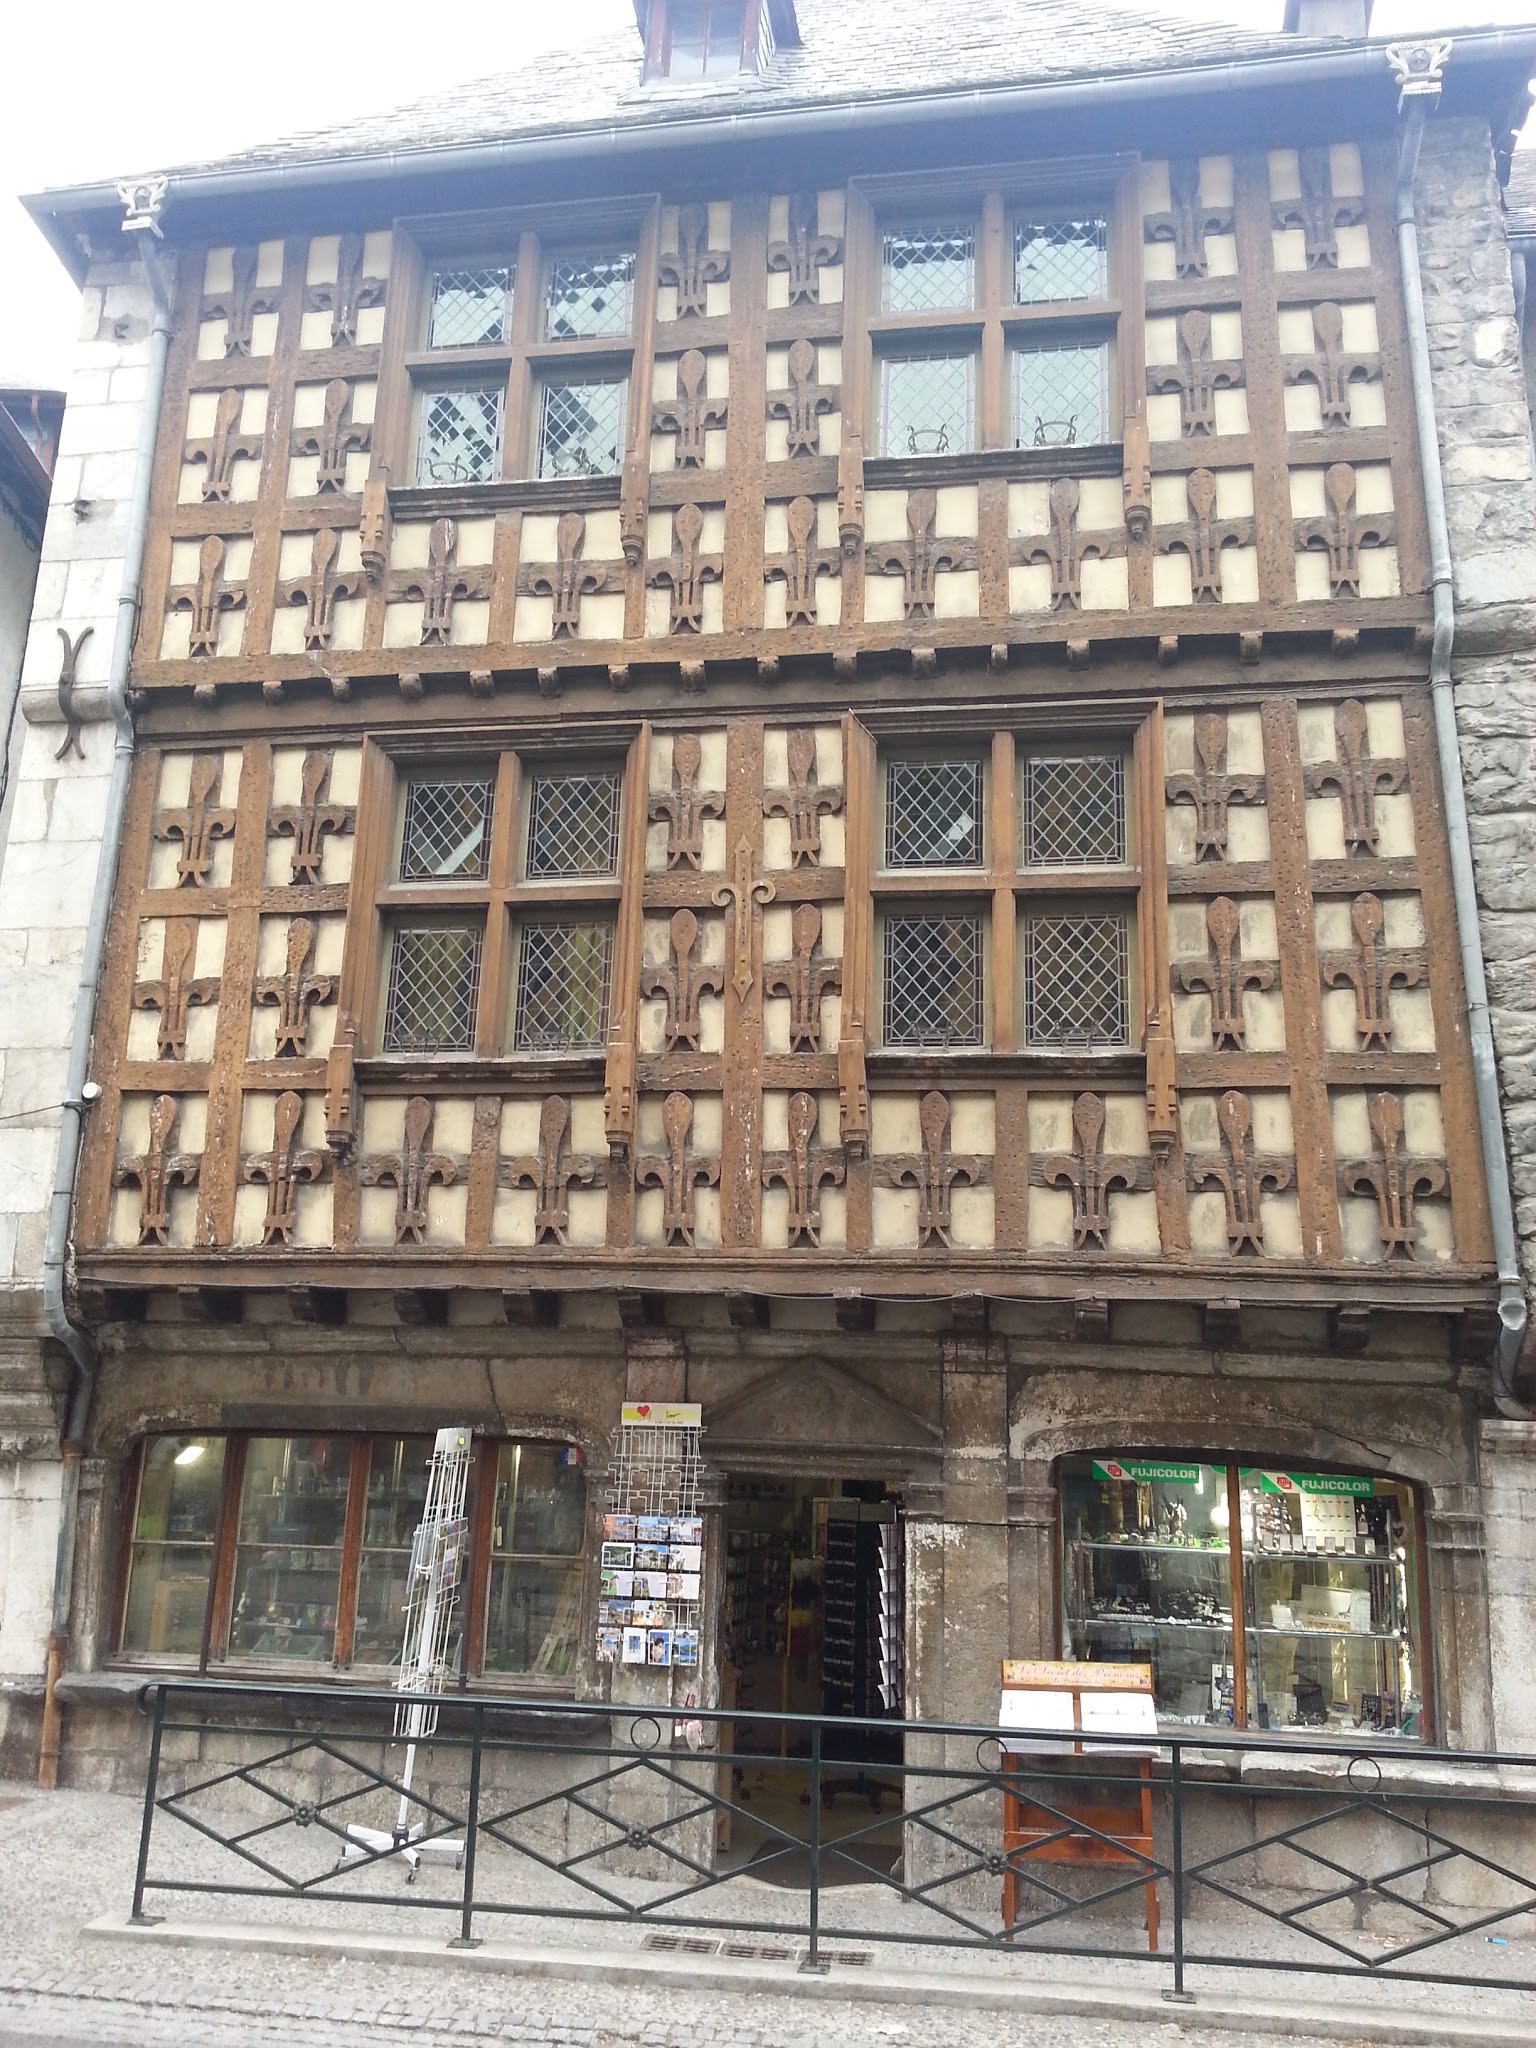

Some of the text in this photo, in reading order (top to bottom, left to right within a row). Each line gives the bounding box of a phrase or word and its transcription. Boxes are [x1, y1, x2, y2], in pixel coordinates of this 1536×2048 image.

[1131, 1466, 1197, 1479] FUJICOLOR
[1301, 1479, 1371, 1492] FUJICOLOR
[1033, 1665, 1070, 1676] Secret
